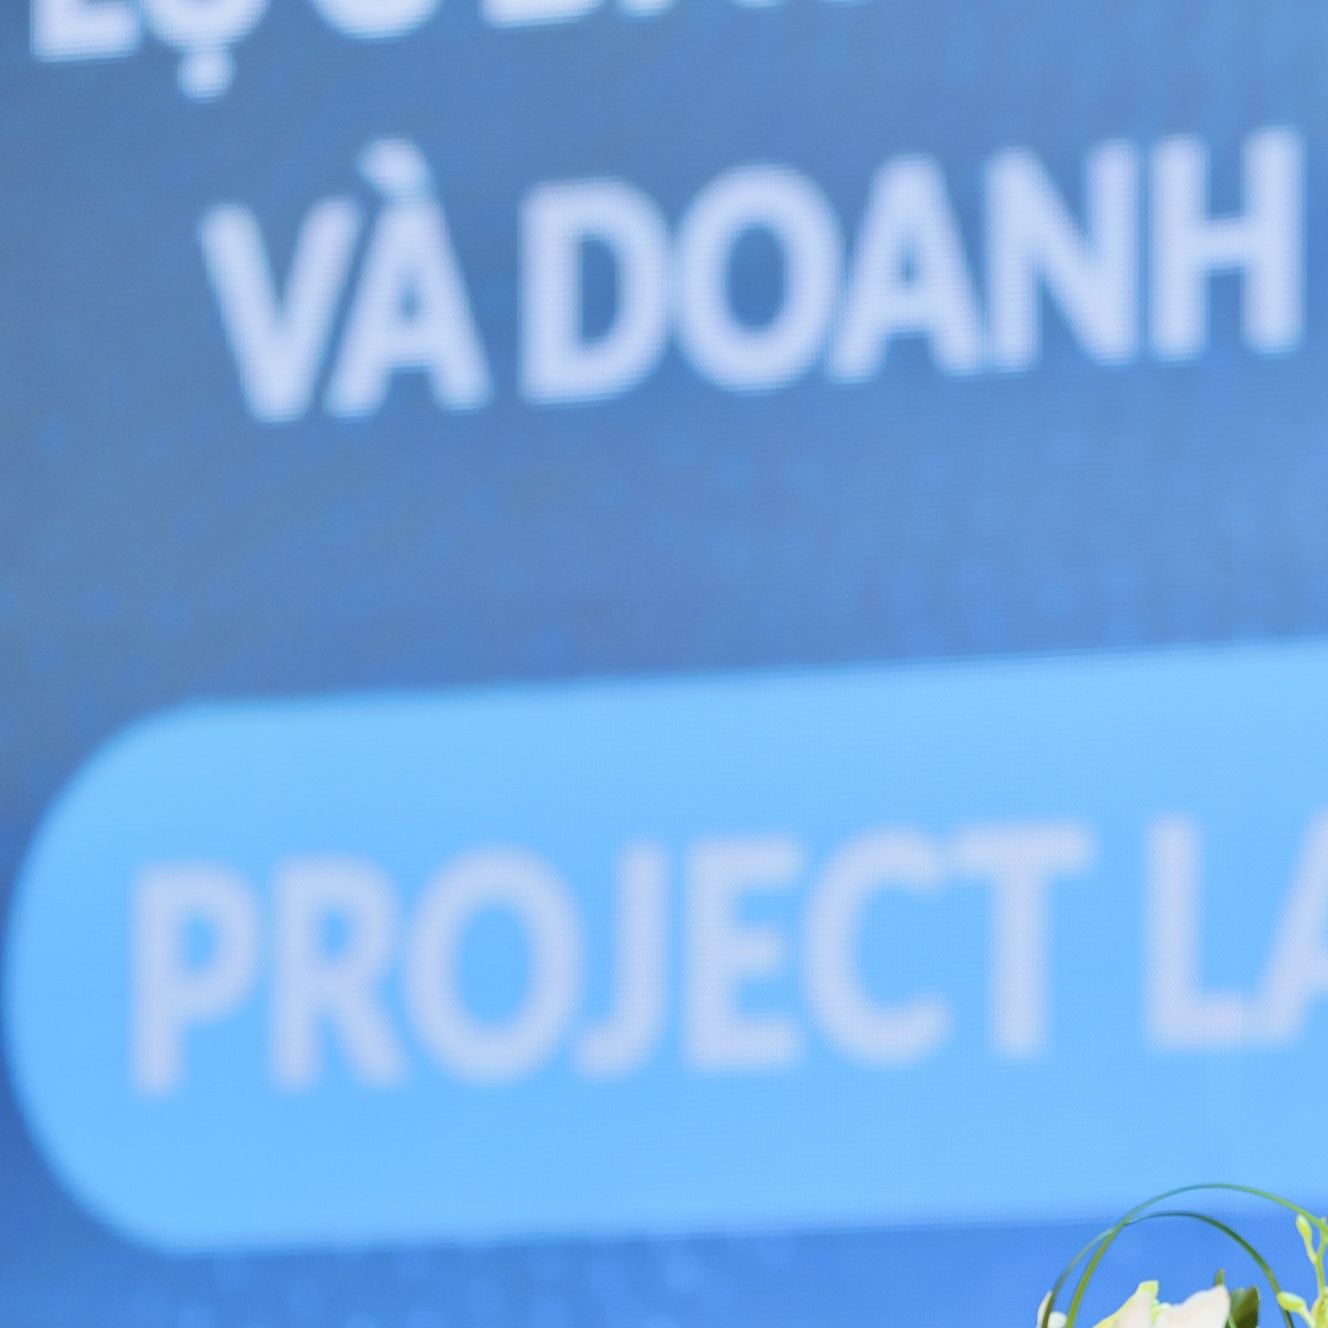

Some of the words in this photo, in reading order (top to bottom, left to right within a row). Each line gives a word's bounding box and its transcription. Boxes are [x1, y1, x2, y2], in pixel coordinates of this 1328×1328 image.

[200, 138, 490, 422] VÀ
[518, 126, 1304, 405] DOANH
[129, 818, 1097, 1096] PROJECT
